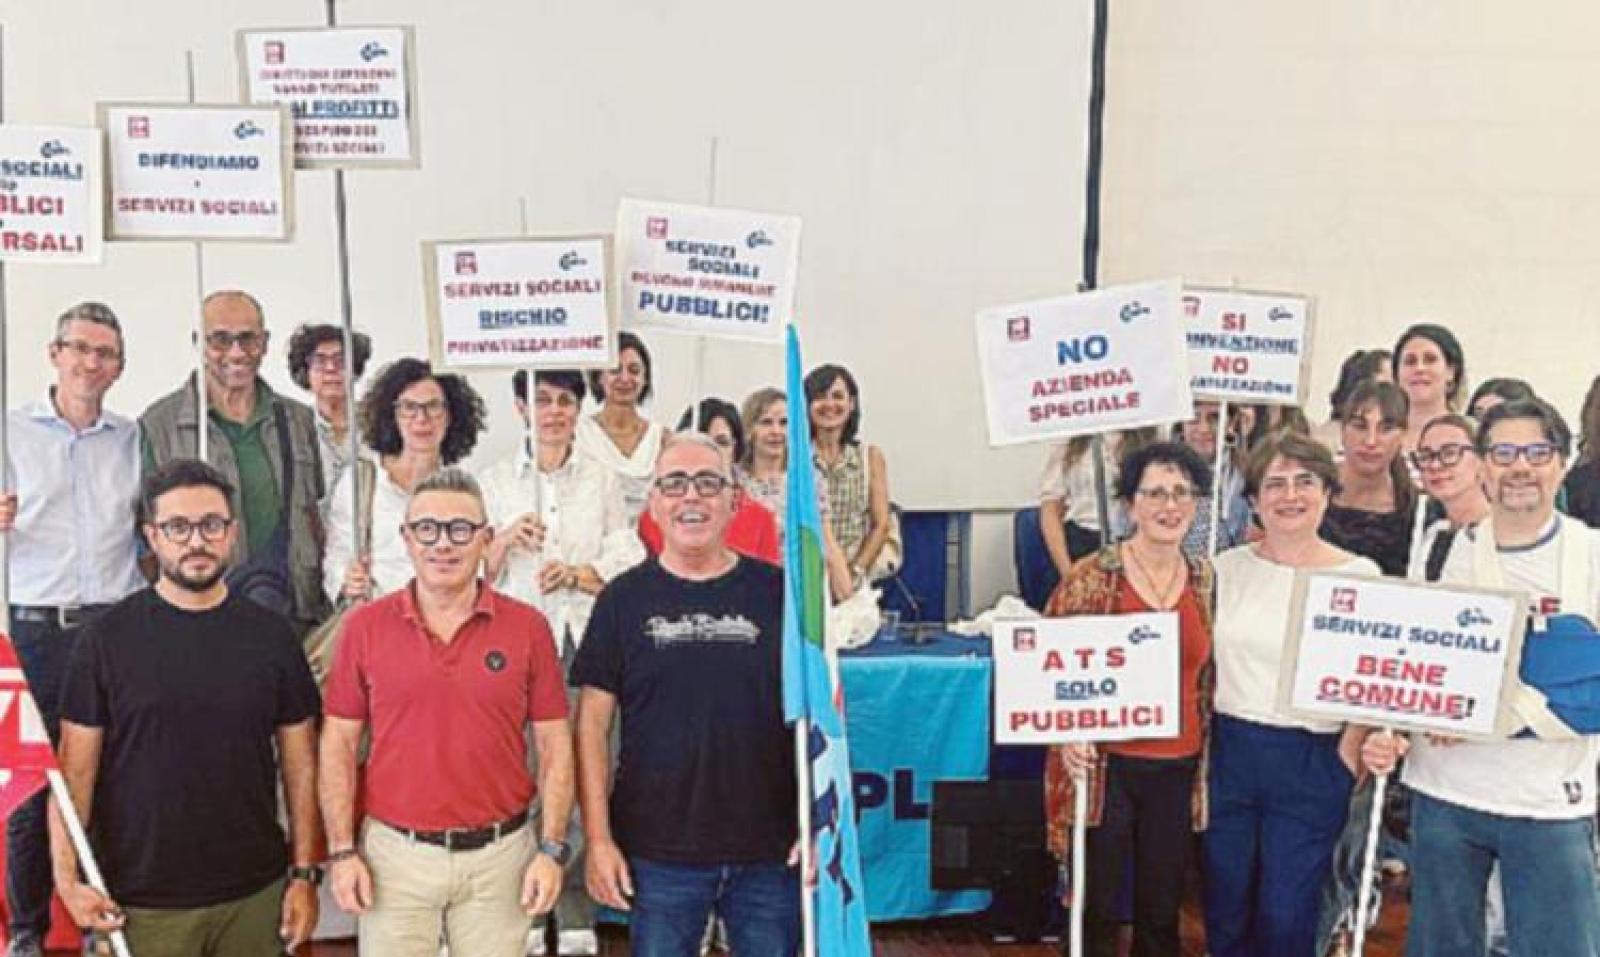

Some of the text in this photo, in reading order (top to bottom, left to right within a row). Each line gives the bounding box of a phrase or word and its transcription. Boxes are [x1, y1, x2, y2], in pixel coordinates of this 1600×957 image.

[1, 160, 84, 180] SOCIALI
[138, 153, 260, 170] DIFENDIAMO
[118, 198, 278, 215] SERVIZI SOCIALI
[665, 240, 737, 259] SERVIZI
[687, 257, 760, 279] SOCIALI
[444, 278, 602, 299] SERVIZI SOCIALI
[478, 306, 568, 330] RISCHIO
[639, 290, 770, 323] PUBBLICI!
[1221, 311, 1247, 332] SI
[447, 335, 605, 354] PRIVATIZZAZIONE
[1056, 334, 1111, 366] NO
[1211, 355, 1249, 376] NO
[1031, 367, 1135, 398] AZIENDA
[1028, 391, 1141, 423] SPECIALE
[1312, 614, 1502, 653] SERVIZI SOCIALI
[1356, 654, 1449, 686] BENE
[1055, 678, 1118, 701] SOLO
[1315, 675, 1477, 720] COMUNE!
[1009, 704, 1164, 732] PUBBLICI
